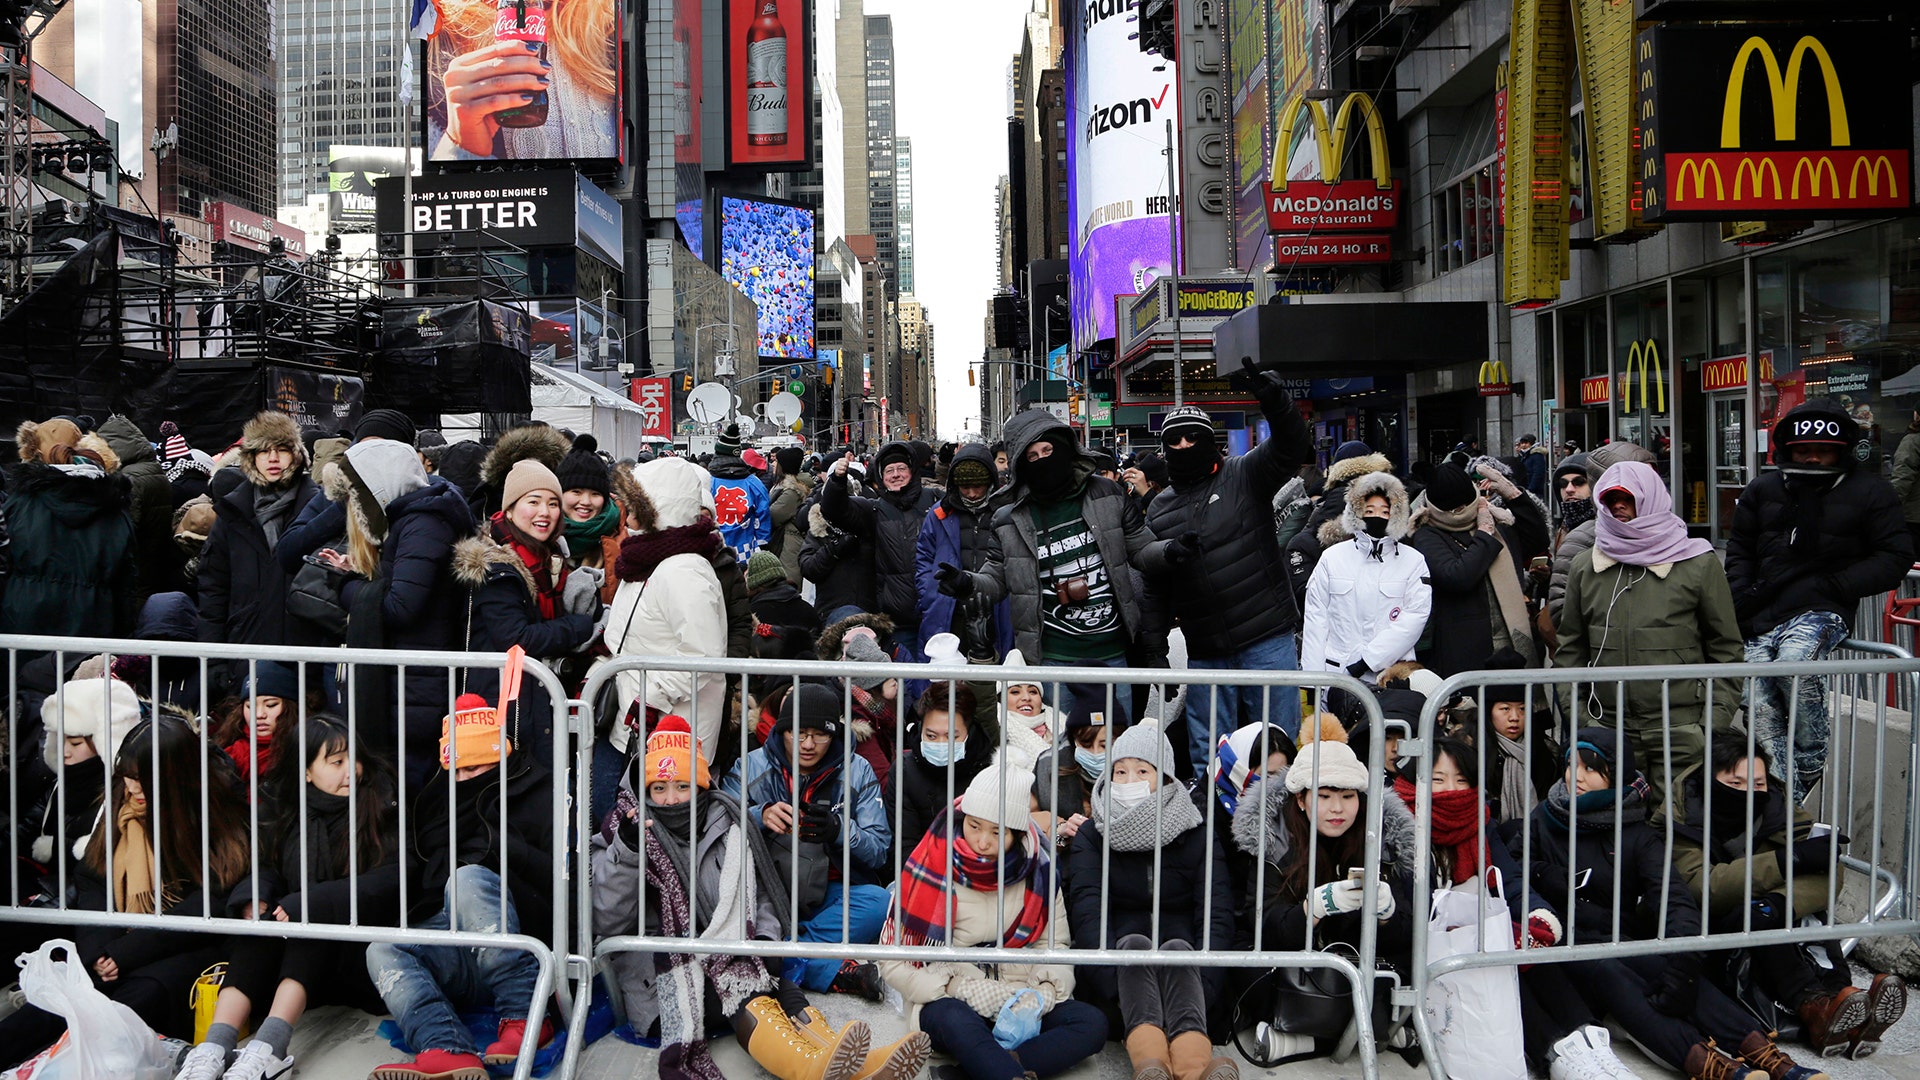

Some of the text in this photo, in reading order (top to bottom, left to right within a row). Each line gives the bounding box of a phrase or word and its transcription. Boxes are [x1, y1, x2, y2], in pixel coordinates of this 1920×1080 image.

[437, 191, 449, 201] 1.6
[451, 190, 480, 200] TURBO
[483, 189, 500, 198] GDI
[502, 188, 536, 198] ENGINE
[539, 187, 548, 196] IS
[1104, 199, 1134, 223] WORLD
[1273, 196, 1393, 213] McDonald's
[413, 201, 538, 232] BETTER
[1292, 213, 1373, 225] Restaurant
[1281, 245, 1318, 256] OPEN
[1322, 245, 1339, 255] 24
[1827, 372, 1869, 385] Extraordinary
[1829, 382, 1868, 393] sandwiches.
[641, 382, 665, 430] tkts
[1793, 420, 1840, 436] 1990
[1065, 604, 1113, 620] JETS
